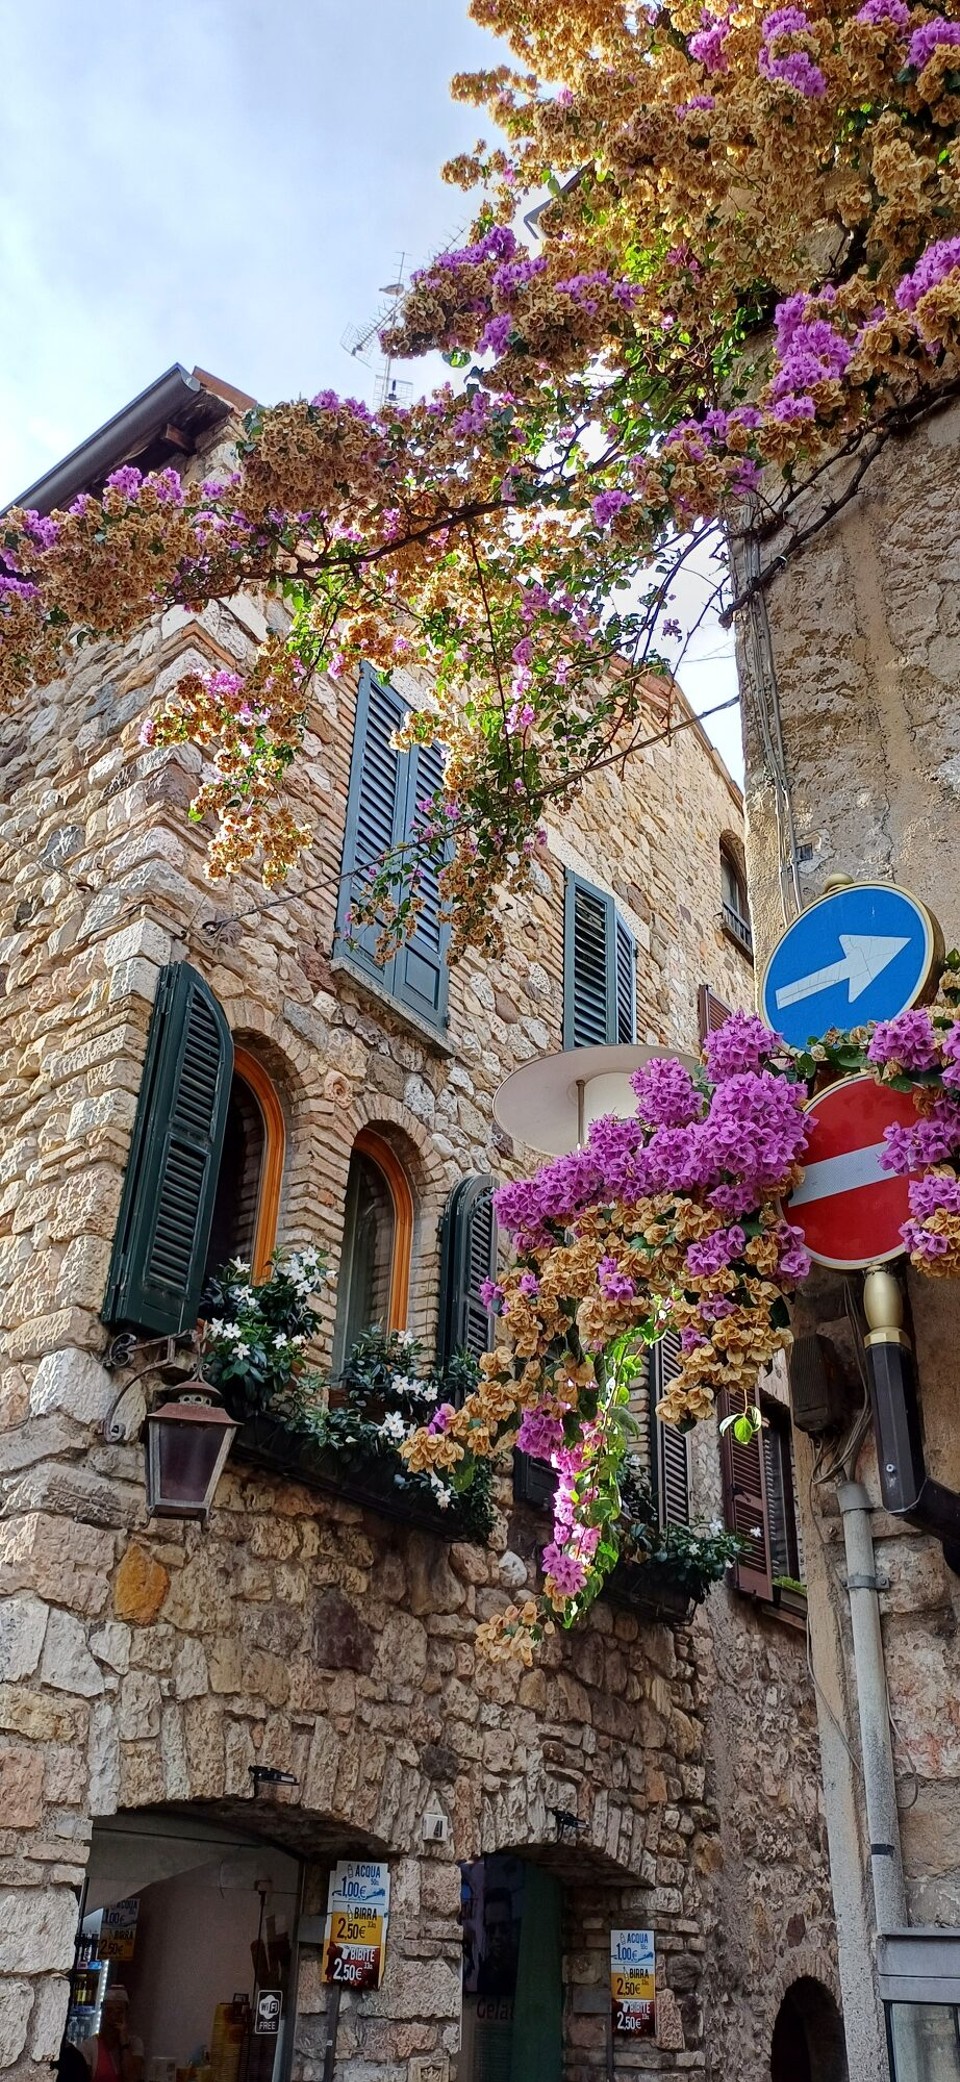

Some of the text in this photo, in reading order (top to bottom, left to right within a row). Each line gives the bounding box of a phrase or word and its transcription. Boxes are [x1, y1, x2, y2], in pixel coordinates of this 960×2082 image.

[433, 1820, 443, 1838] 4
[354, 1864, 381, 1878] ACQUA
[354, 1906, 378, 1921] BIRRA
[336, 1917, 367, 1940] 2,50€
[626, 1932, 649, 1944] ACQUA
[350, 1946, 376, 1962] BIBITE
[332, 1957, 363, 1981] 2,50€
[629, 1968, 650, 1979] BIRRA
[616, 1977, 641, 1996] 2,50€
[629, 2001, 651, 2014] BIBITE
[259, 2021, 276, 2030] FREE
[616, 2011, 642, 2030] 2,50€
